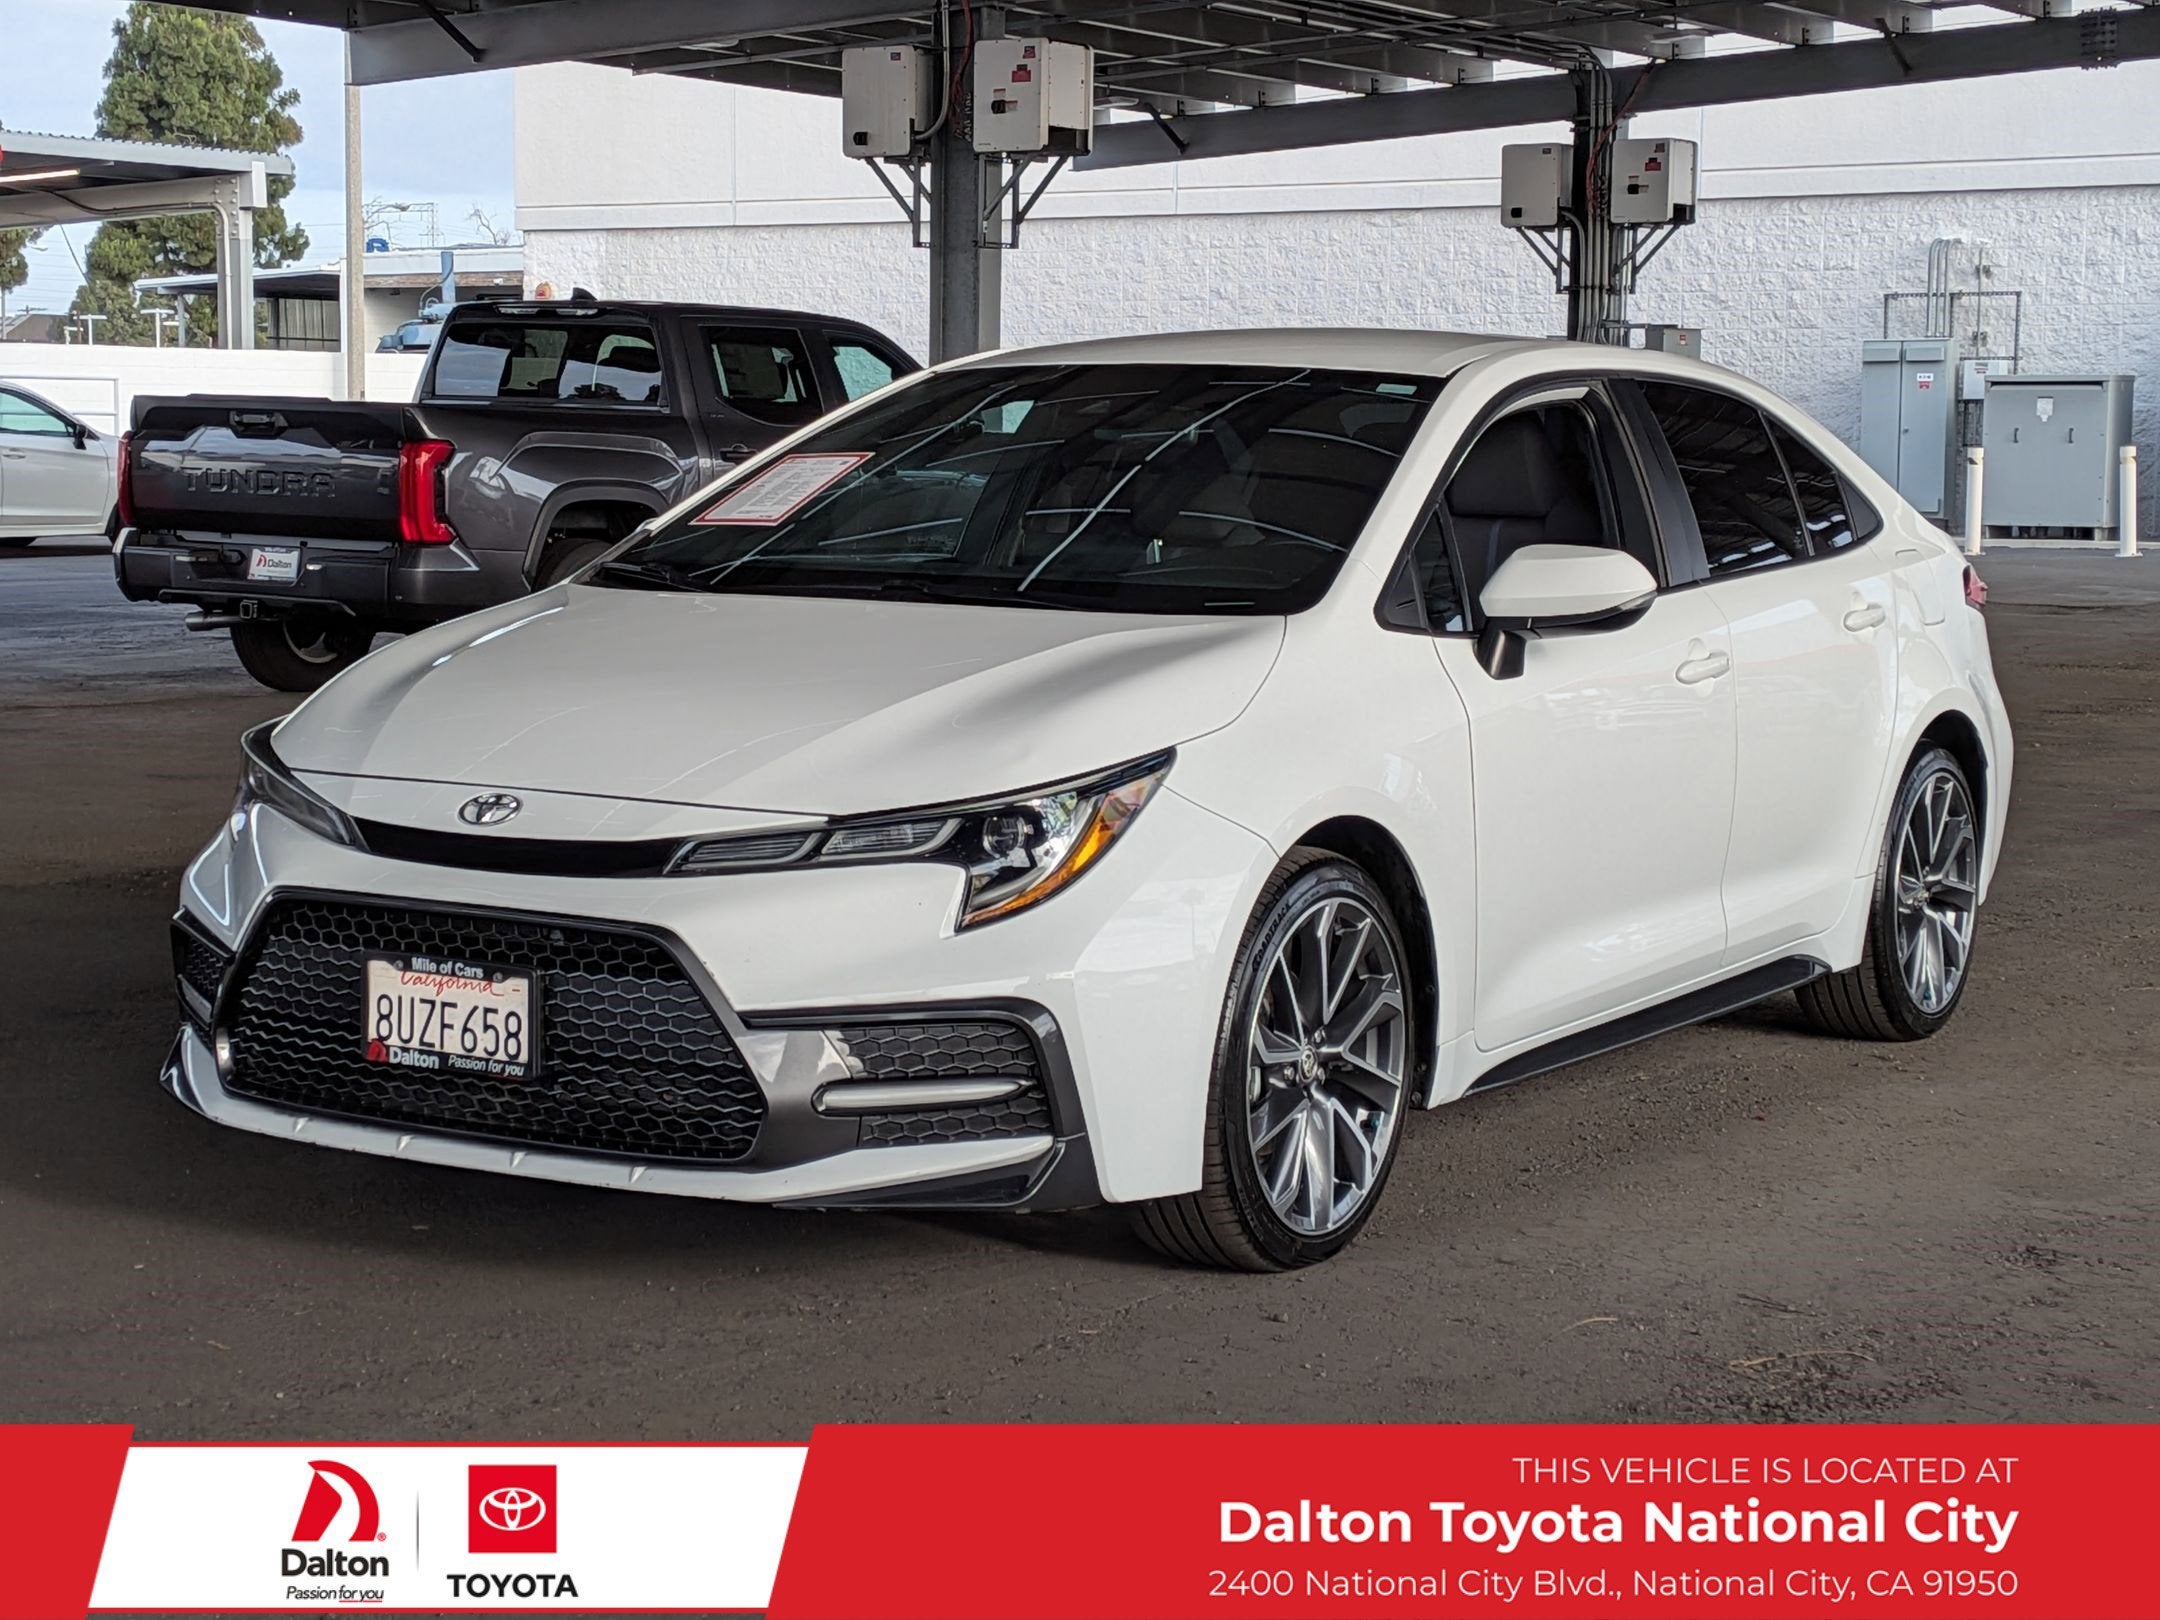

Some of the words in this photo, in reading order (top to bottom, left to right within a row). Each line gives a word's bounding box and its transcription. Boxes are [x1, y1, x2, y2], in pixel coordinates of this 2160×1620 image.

[180, 466, 336, 497] TUNDRA
[411, 956, 437, 973] Mile
[439, 960, 453, 975] of
[454, 964, 484, 979] Cars
[376, 993, 522, 1060] 8UZF658
[389, 1046, 440, 1070] Dalton
[448, 1054, 486, 1071] Passion
[487, 1059, 503, 1074] for
[504, 1064, 525, 1077] you
